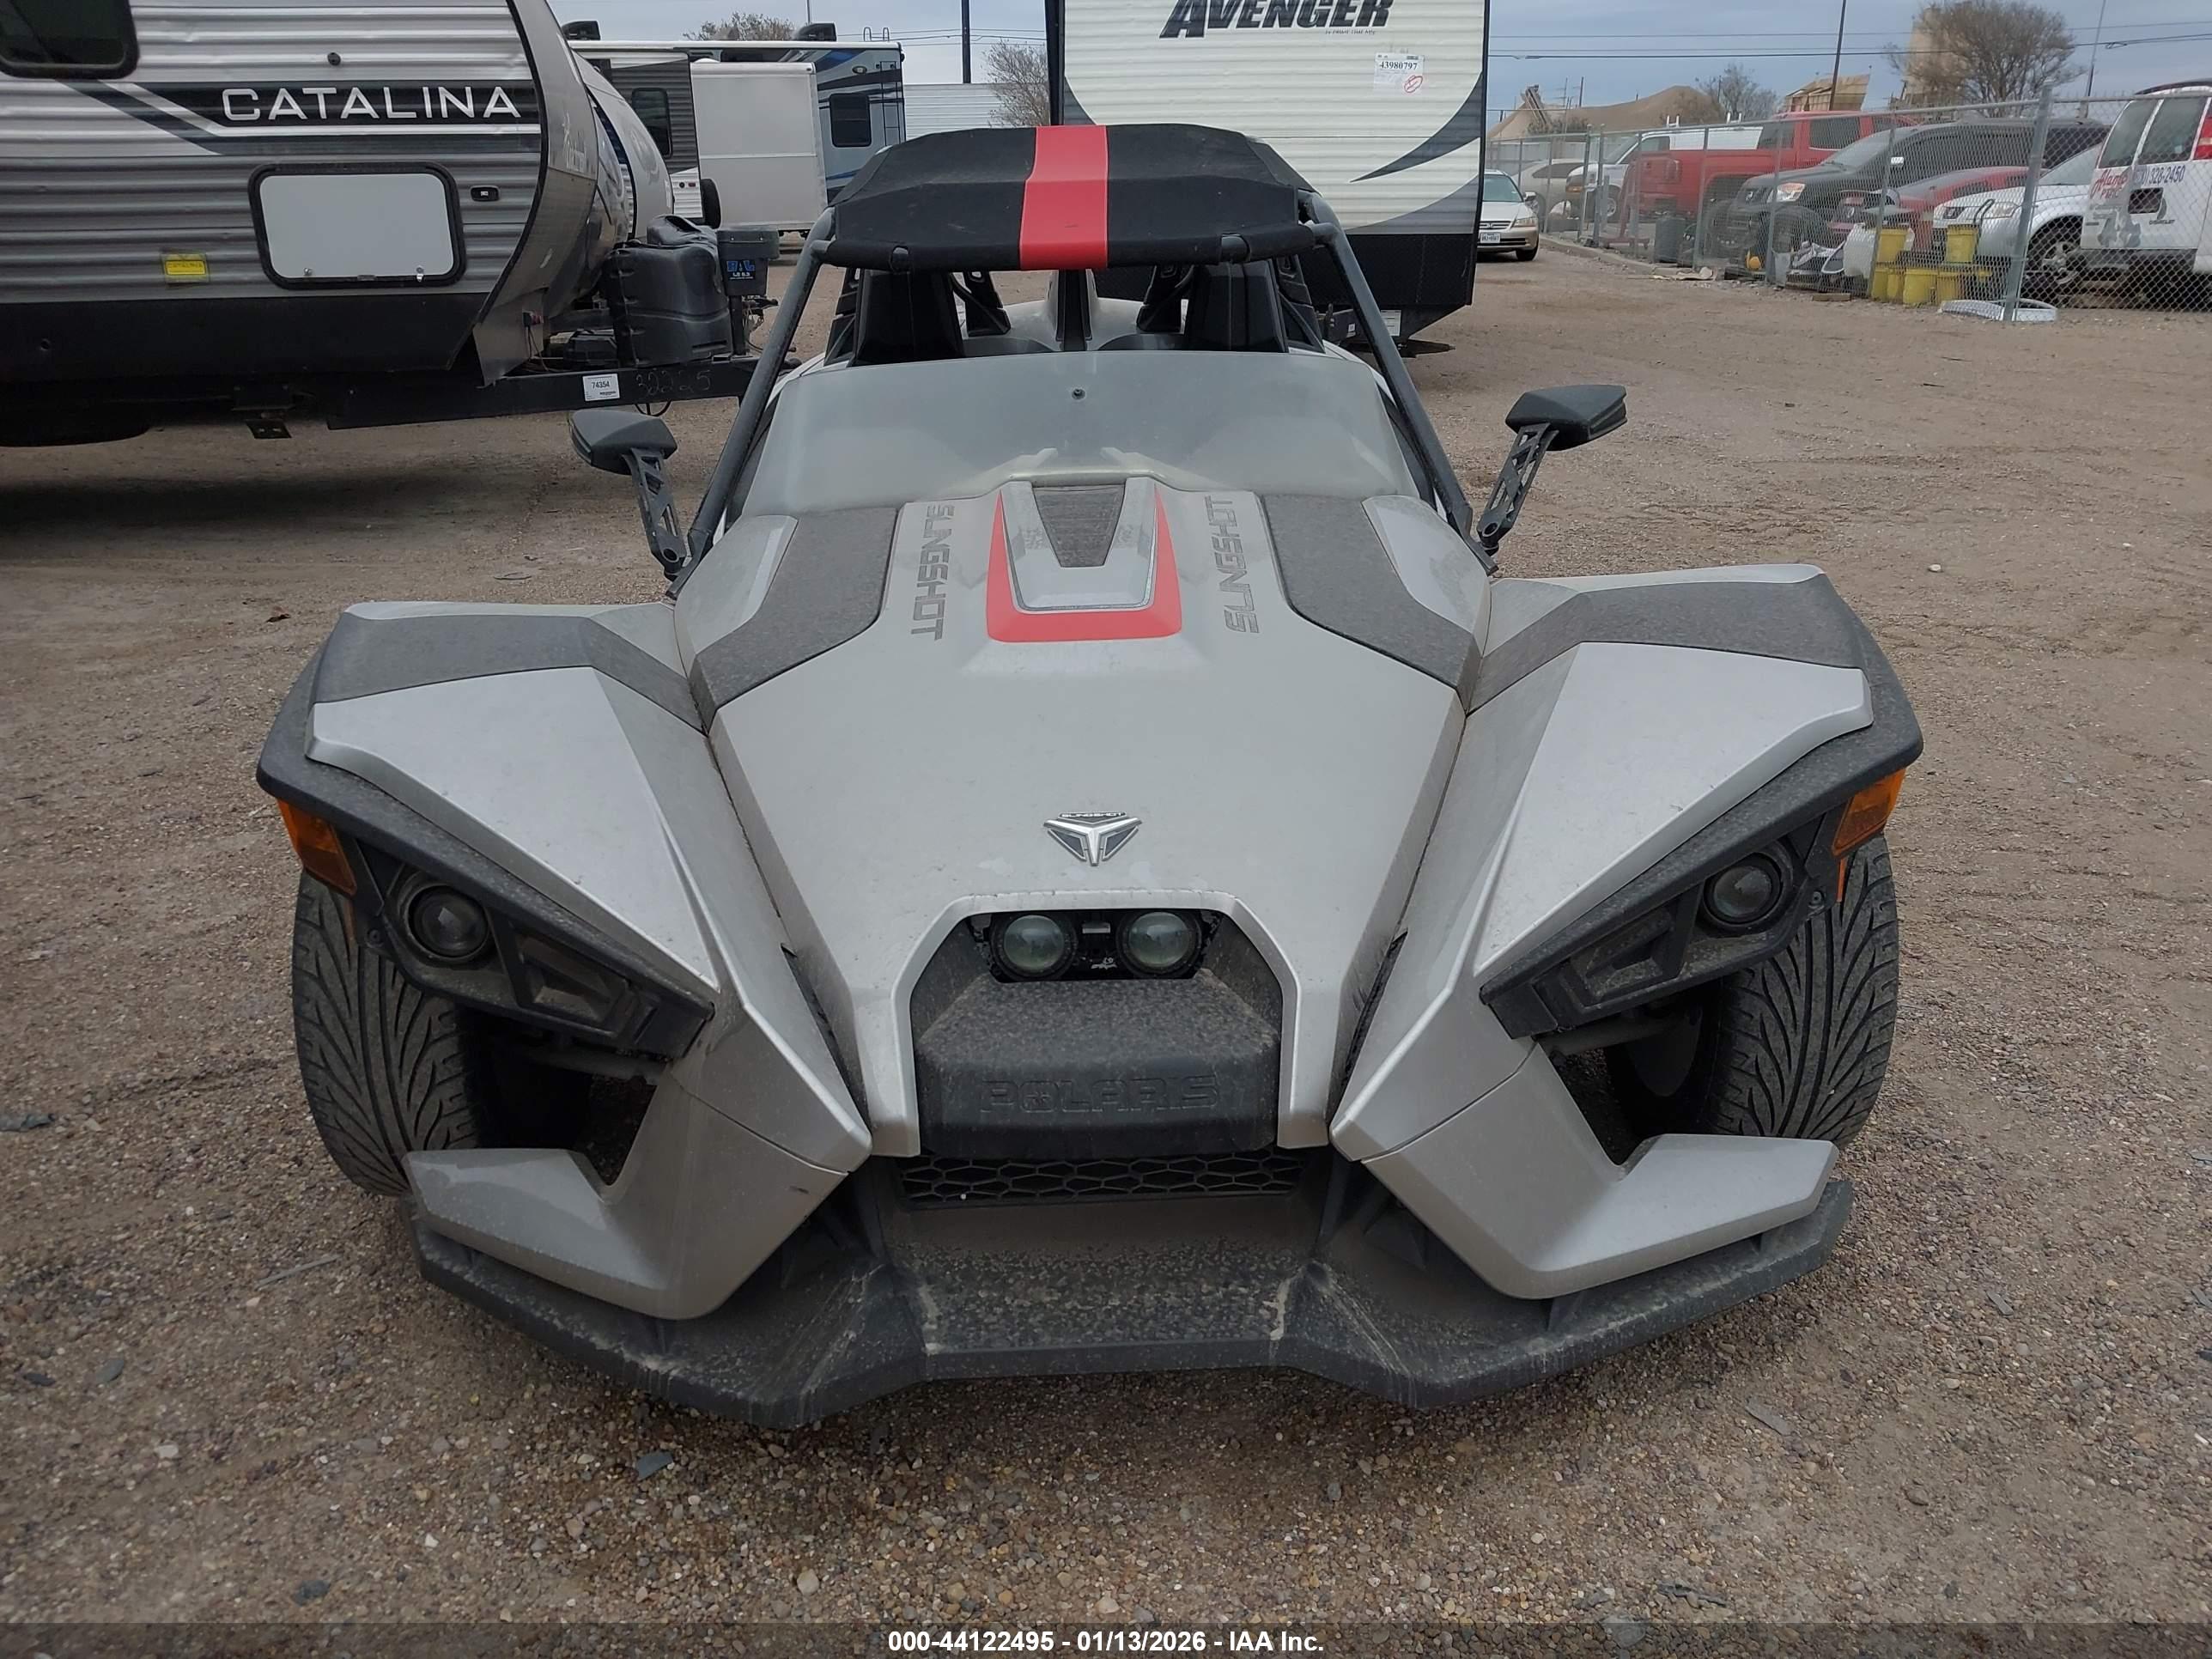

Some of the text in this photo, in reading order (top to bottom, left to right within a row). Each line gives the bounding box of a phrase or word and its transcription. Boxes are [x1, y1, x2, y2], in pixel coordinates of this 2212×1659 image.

[1158, 0, 1394, 38] AVENGER
[1379, 61, 1418, 70] 43980797
[222, 87, 521, 120] CATALINA
[591, 380, 610, 389] 74354
[911, 503, 955, 641] SLINGSHOT
[1204, 495, 1260, 634] SLINGSHOT
[981, 1075, 1219, 1113] POLARIS
